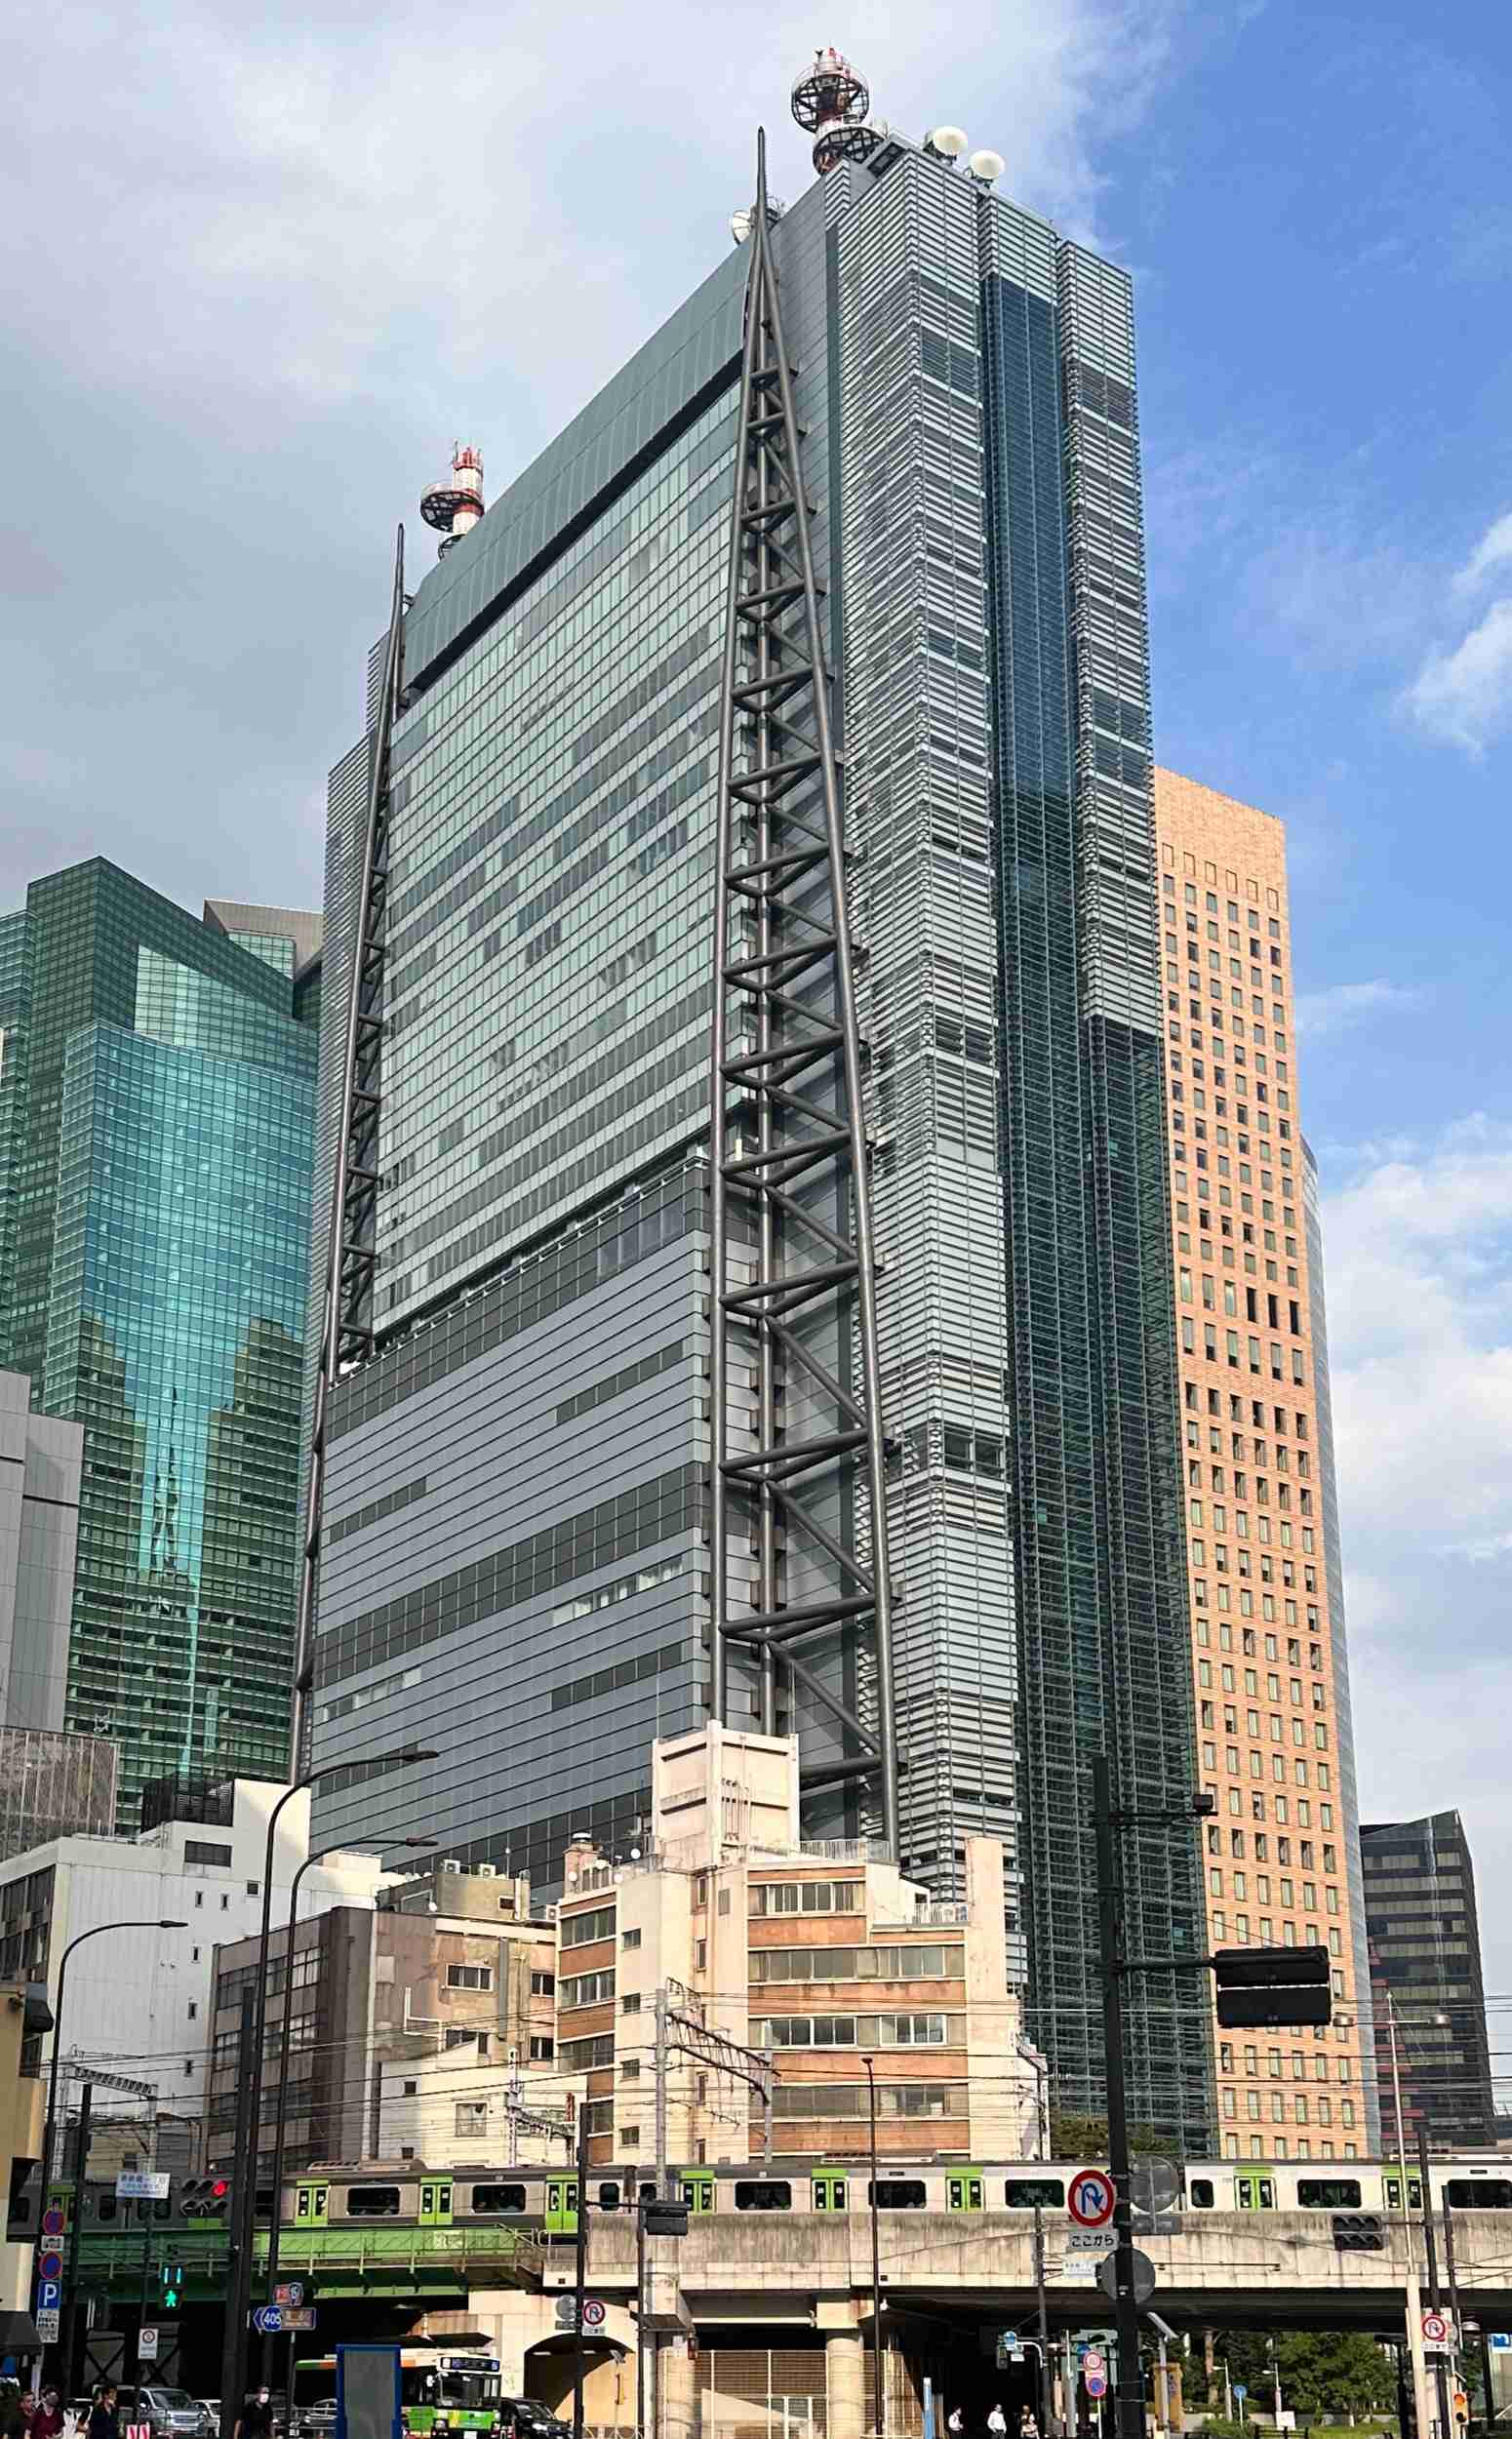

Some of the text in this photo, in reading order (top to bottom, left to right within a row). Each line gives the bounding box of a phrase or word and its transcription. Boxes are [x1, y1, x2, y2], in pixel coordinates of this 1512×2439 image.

[1072, 2234, 1114, 2247] ここから
[43, 2283, 57, 2306] P
